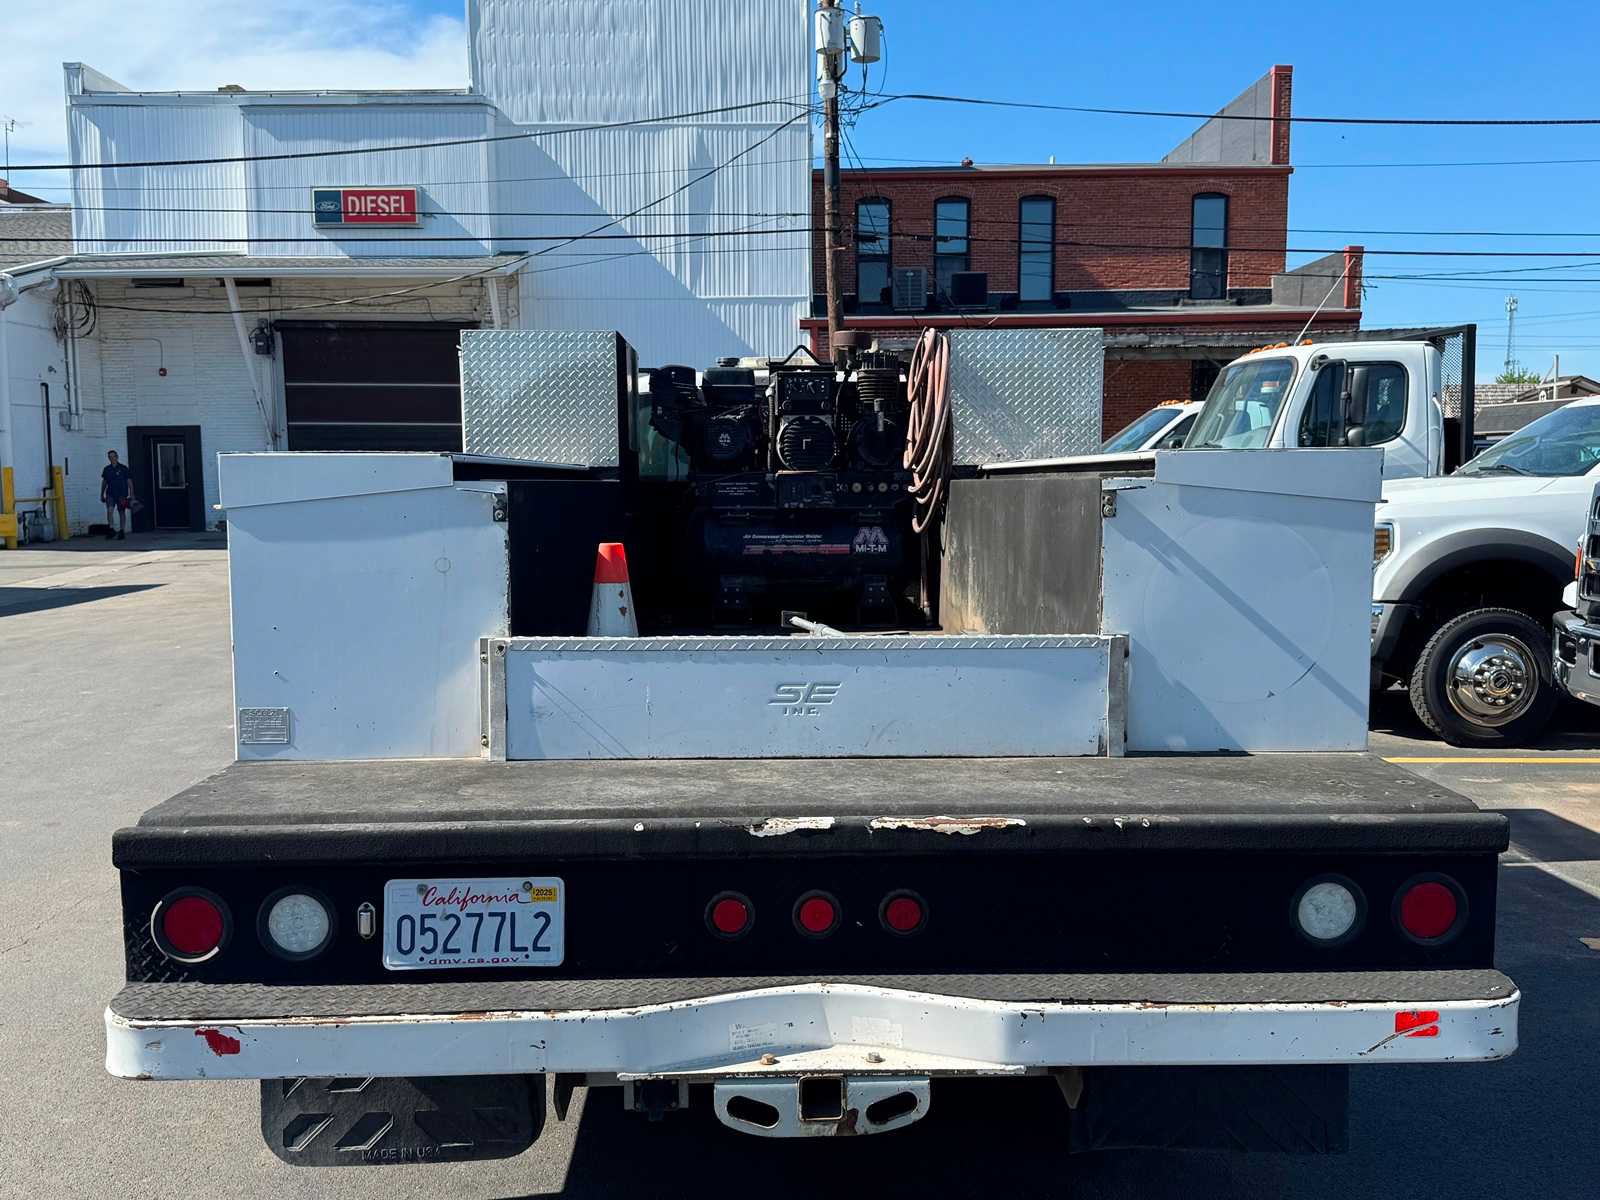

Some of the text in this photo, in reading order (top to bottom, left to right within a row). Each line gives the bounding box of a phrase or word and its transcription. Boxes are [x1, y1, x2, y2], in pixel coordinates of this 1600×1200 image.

[347, 194, 411, 216] DIESEL
[855, 544, 887, 553] MI-T-M
[422, 886, 532, 912] California
[535, 888, 553, 897] 2025
[396, 911, 552, 956] 05277L2
[428, 956, 520, 966] dmv.ca.gov
[361, 1147, 397, 1160] MADE
[401, 1146, 413, 1159] IN
